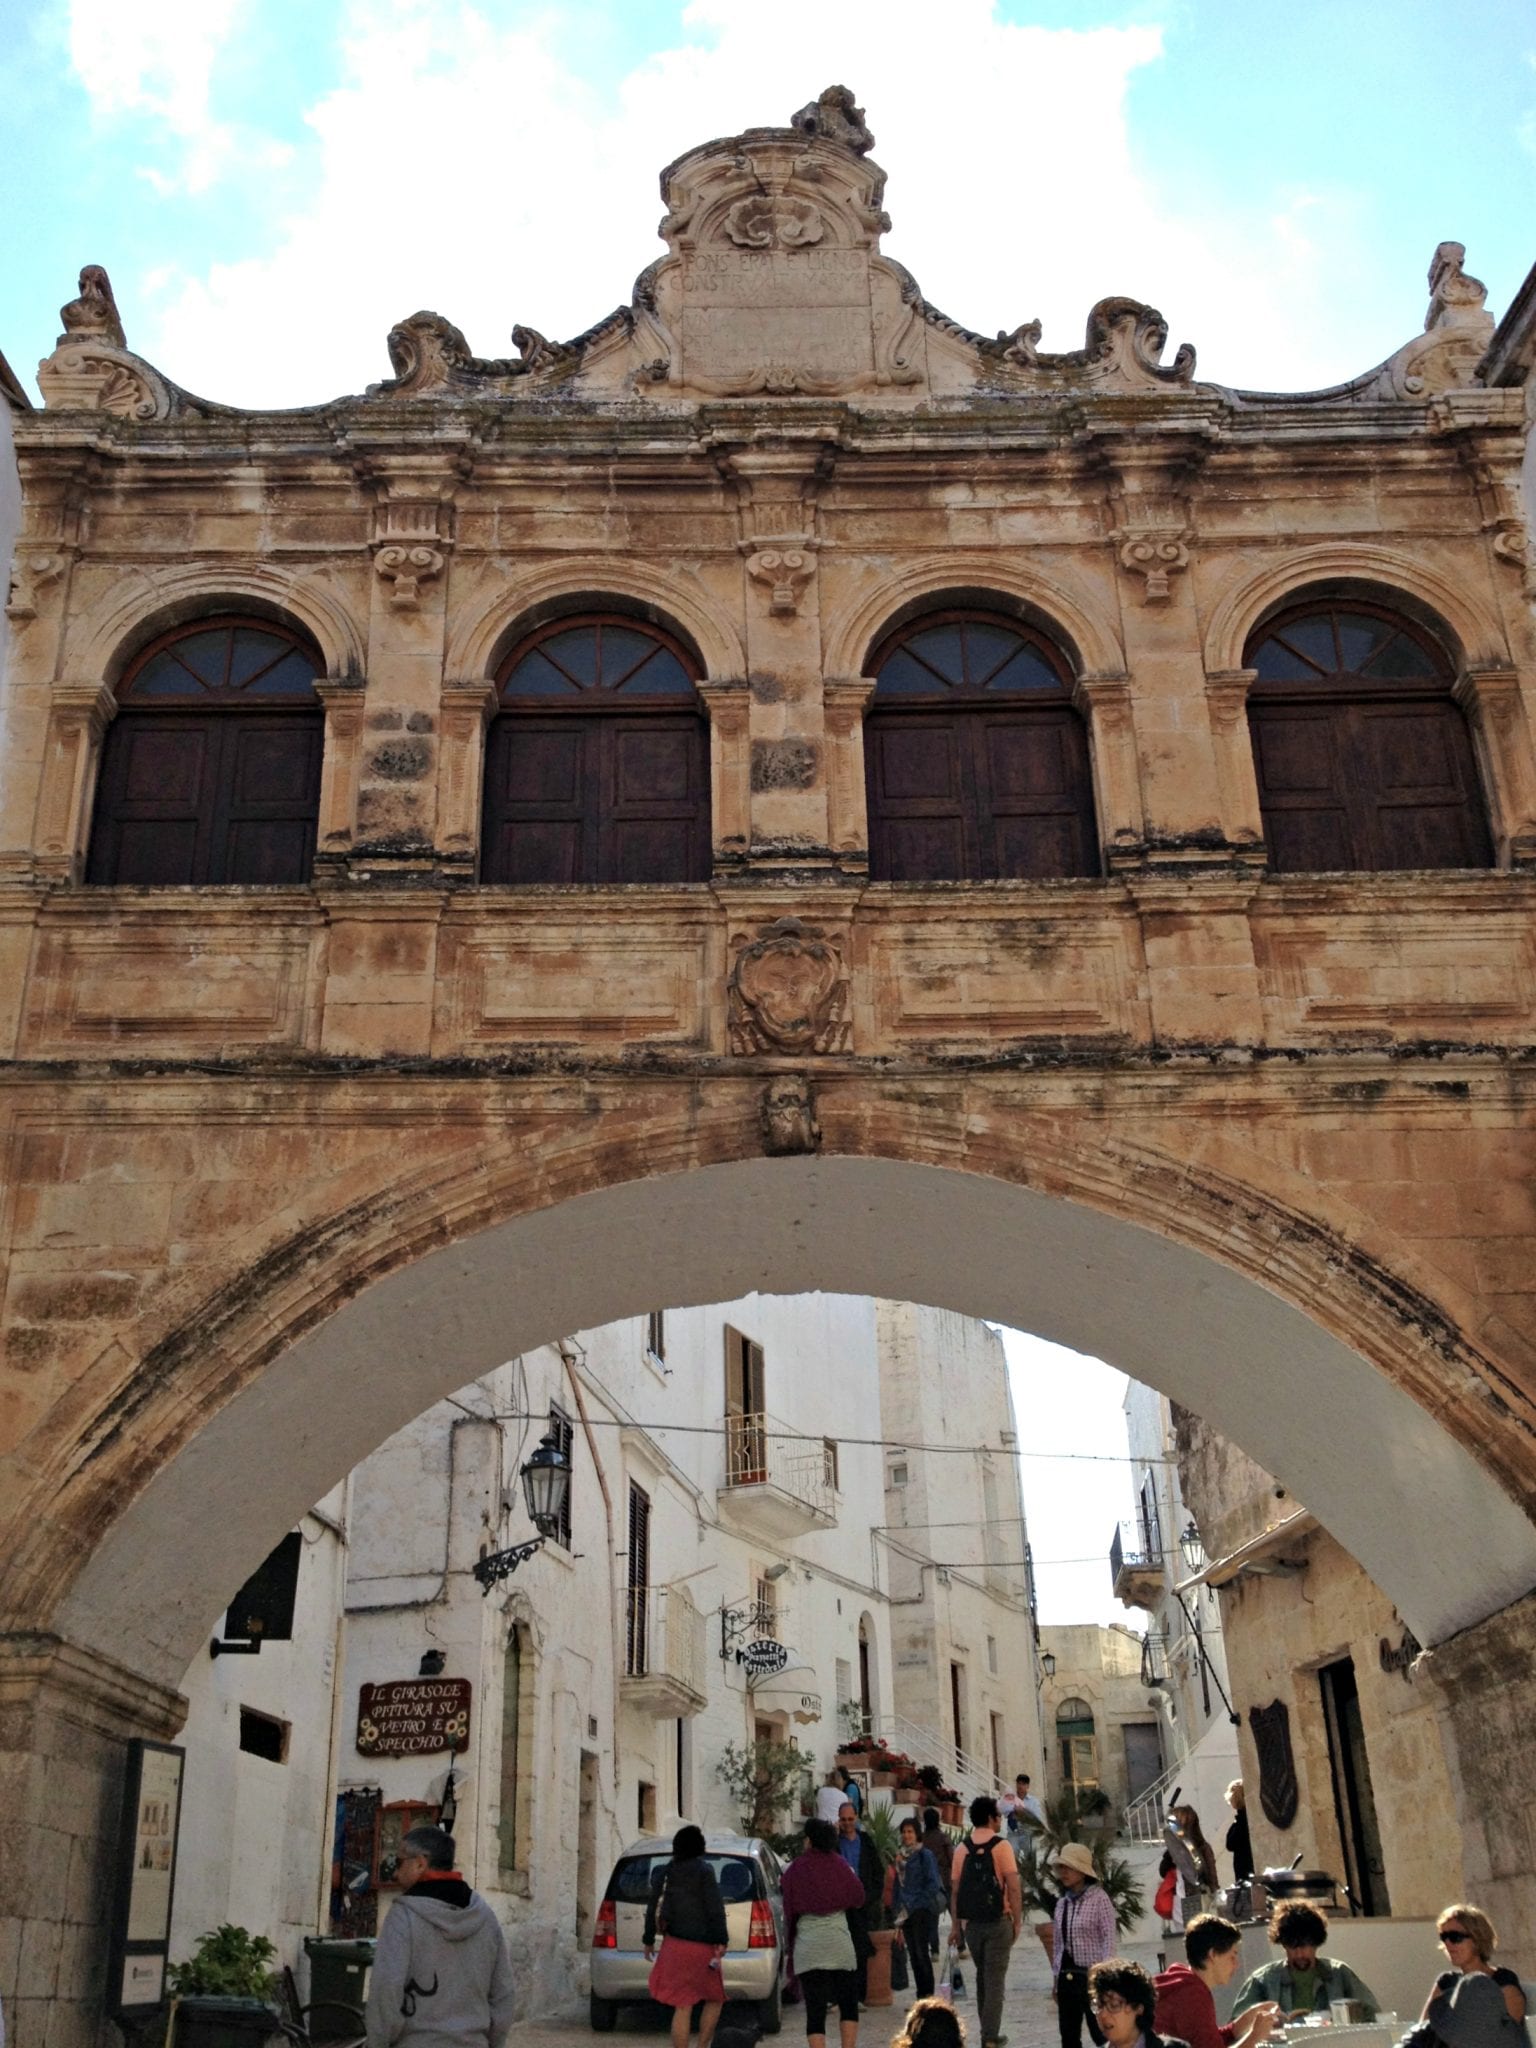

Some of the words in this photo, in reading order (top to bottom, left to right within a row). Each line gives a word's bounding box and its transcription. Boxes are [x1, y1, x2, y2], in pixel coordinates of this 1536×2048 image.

[684, 252, 730, 273] PONS
[370, 1688, 386, 1701] IL
[391, 1684, 462, 1703] GIRASOLE
[371, 1702, 434, 1719] PITTURA
[437, 1700, 459, 1716] SU
[379, 1719, 426, 1734] VETRO
[432, 1718, 444, 1732] E
[375, 1735, 444, 1751] SPECCHIO
